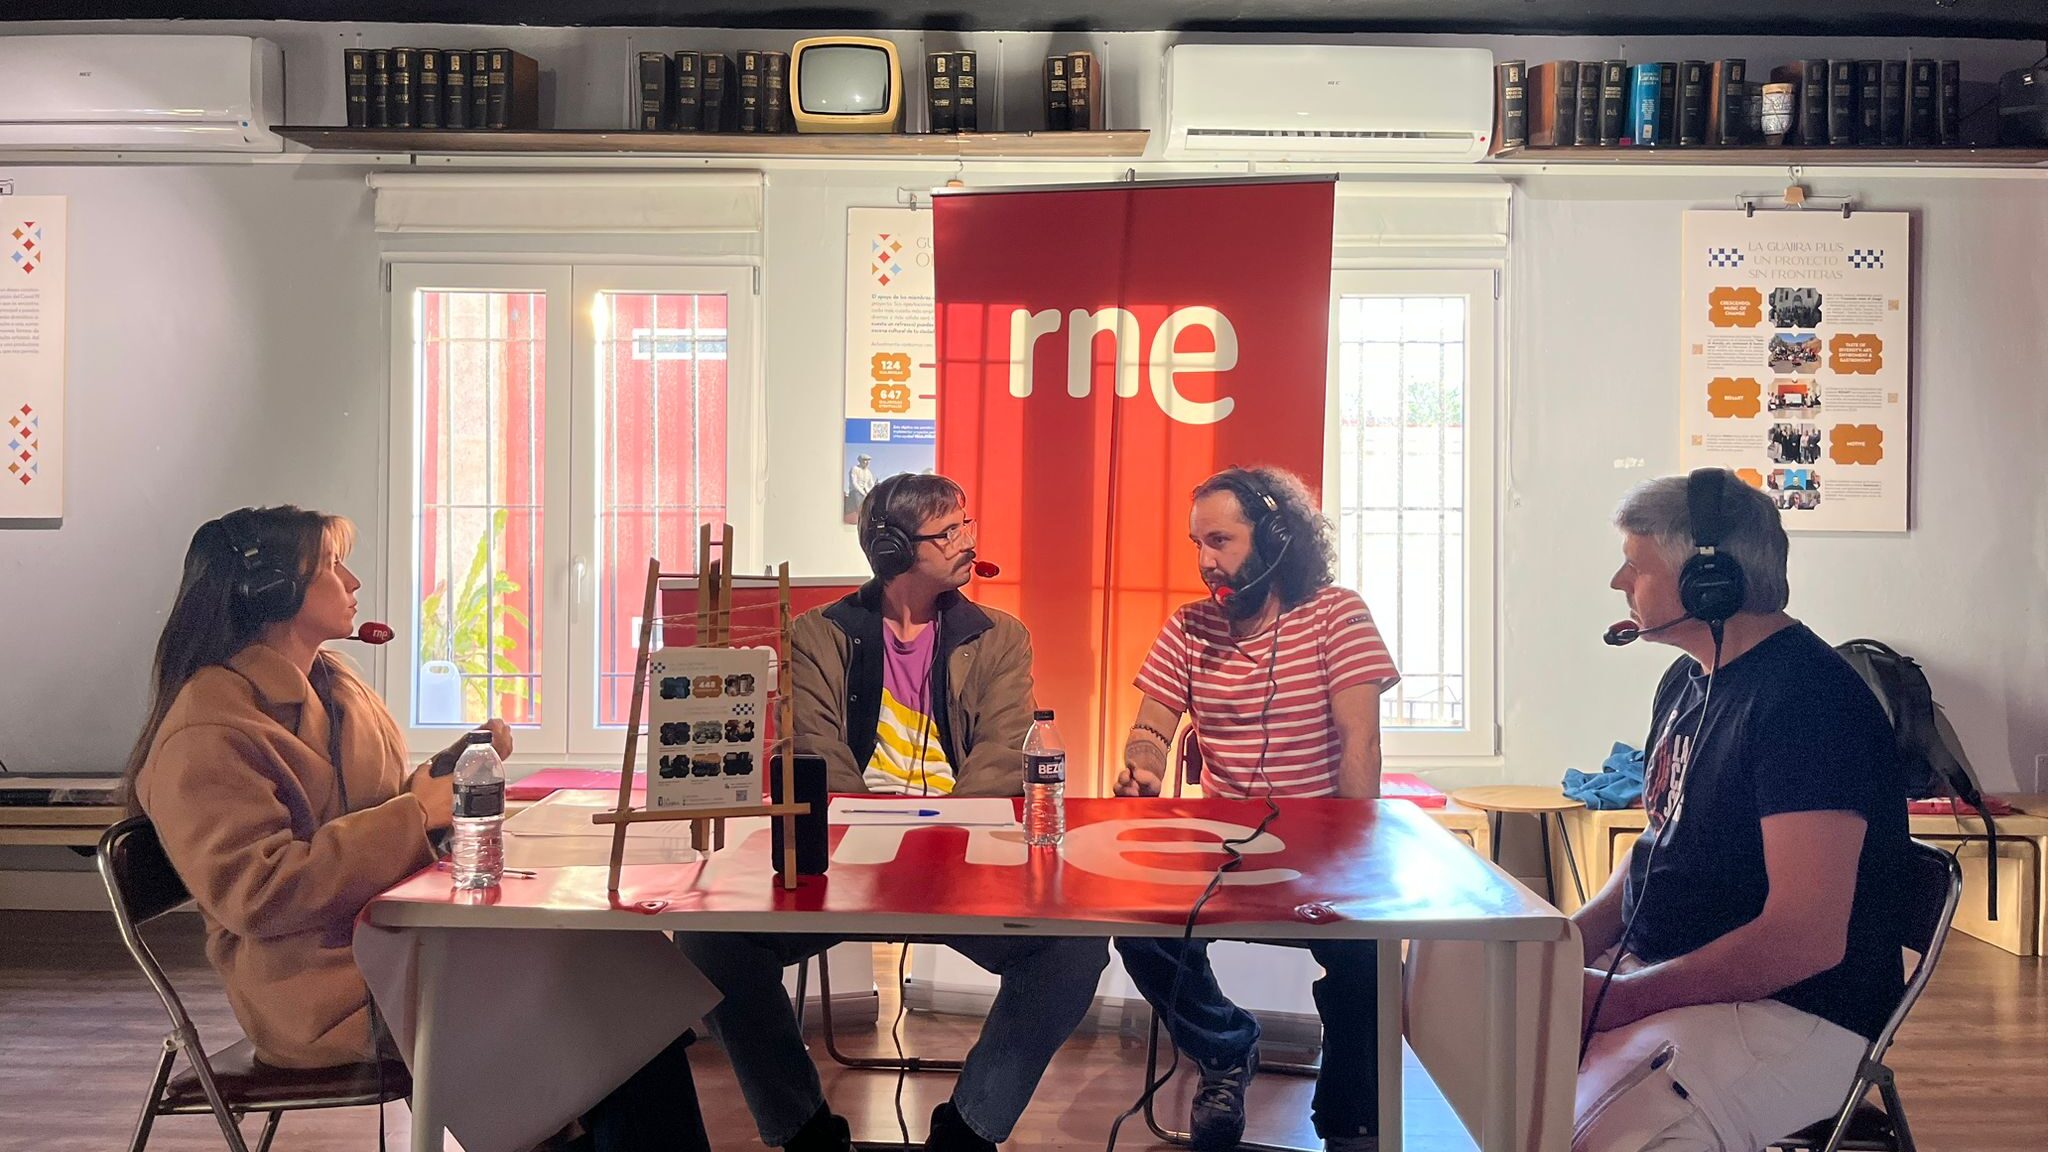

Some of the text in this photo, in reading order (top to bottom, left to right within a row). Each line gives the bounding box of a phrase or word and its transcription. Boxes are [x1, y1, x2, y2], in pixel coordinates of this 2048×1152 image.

[1748, 242, 1763, 252] LA
[1815, 242, 1844, 252] PLUS
[1753, 255, 1838, 266] UN PROYECTO
[1748, 269, 1844, 280] SIN FRONTERAS
[881, 360, 901, 370] 124
[1009, 305, 1238, 425] rne
[880, 389, 902, 400] 647
[372, 629, 388, 640] rne
[1038, 763, 1060, 775] BEZ
